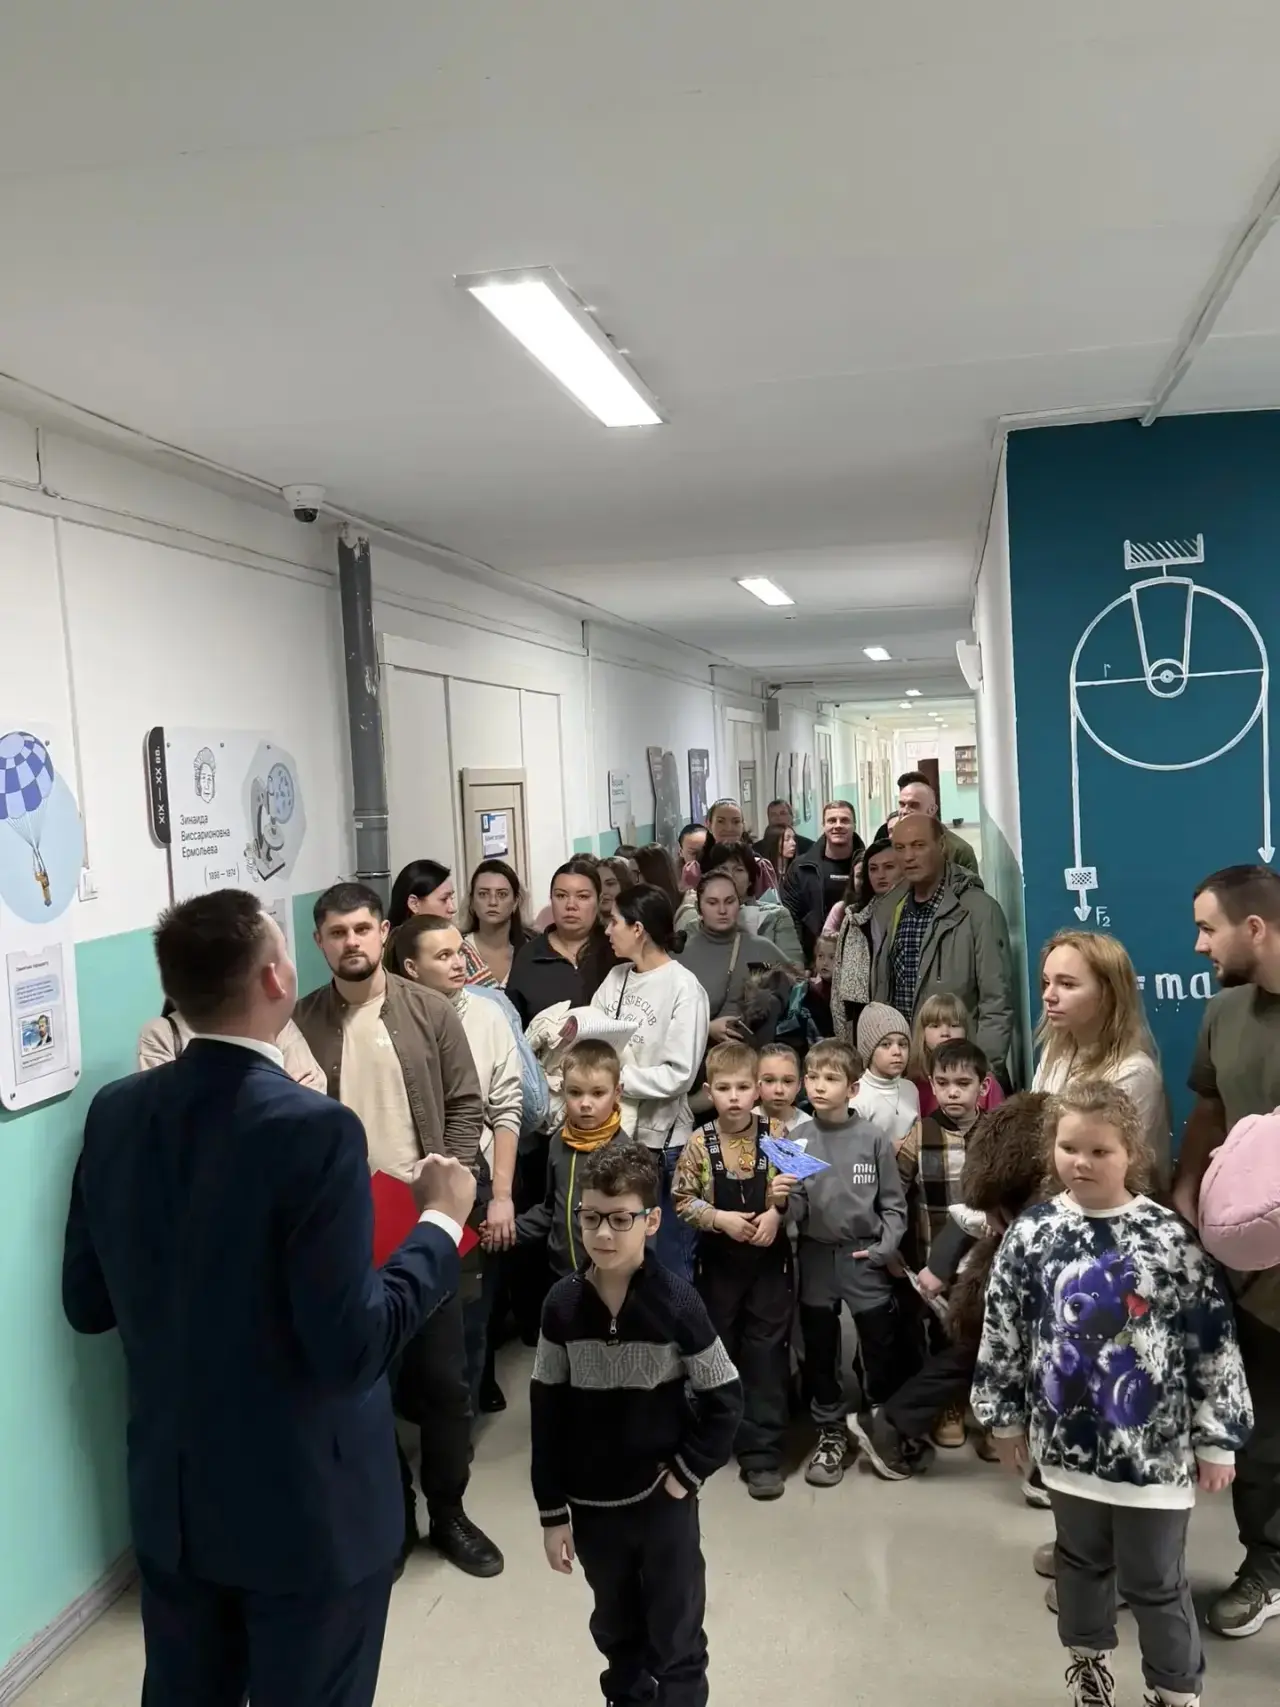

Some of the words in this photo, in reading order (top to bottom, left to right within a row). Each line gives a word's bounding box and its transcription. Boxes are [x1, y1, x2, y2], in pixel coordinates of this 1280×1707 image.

[155, 767, 162, 784] XX
[180, 814, 208, 825] Зинаида
[181, 828, 231, 843] Виссарионовна
[182, 845, 218, 860] Ермольева
